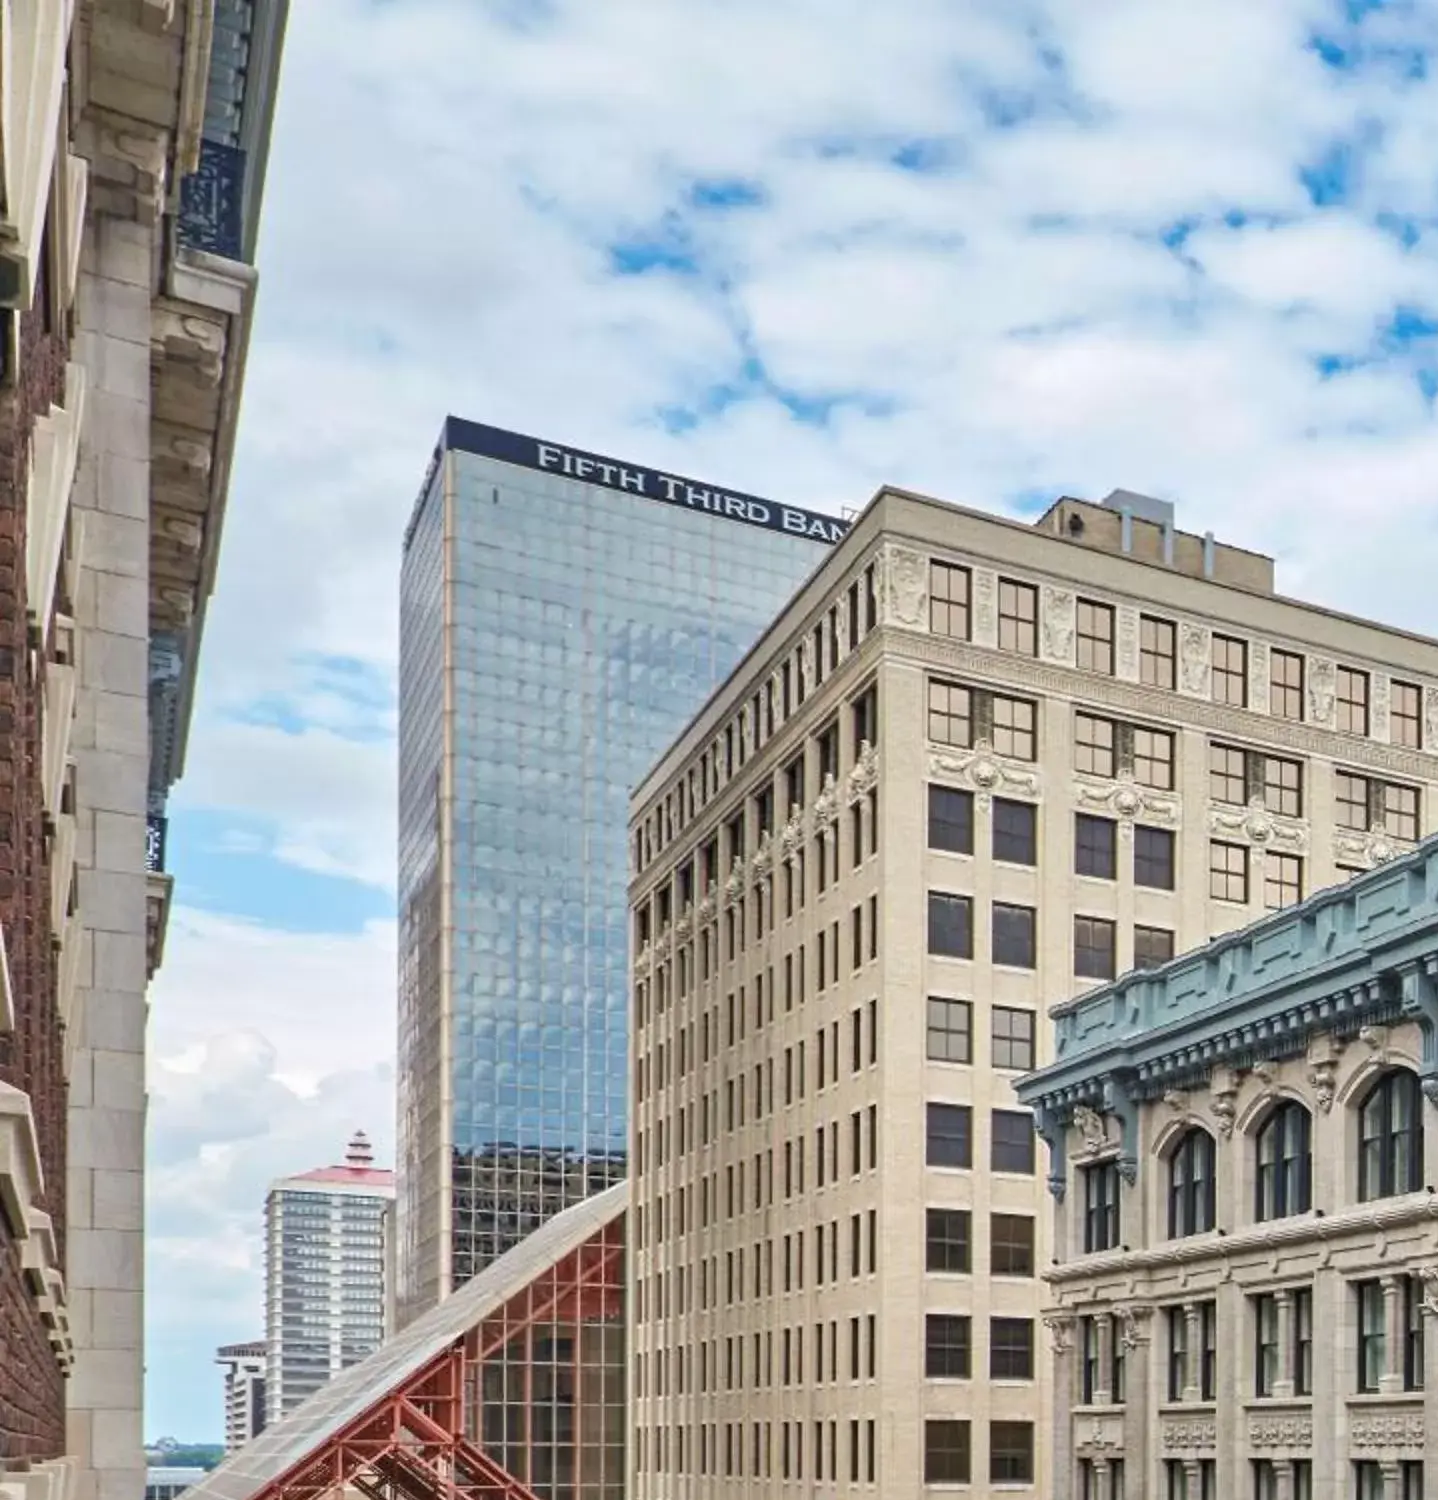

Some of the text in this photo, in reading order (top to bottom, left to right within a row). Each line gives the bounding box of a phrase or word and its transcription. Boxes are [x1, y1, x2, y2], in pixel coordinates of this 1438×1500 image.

[537, 443, 850, 542] FIFTH THIRD BAN
